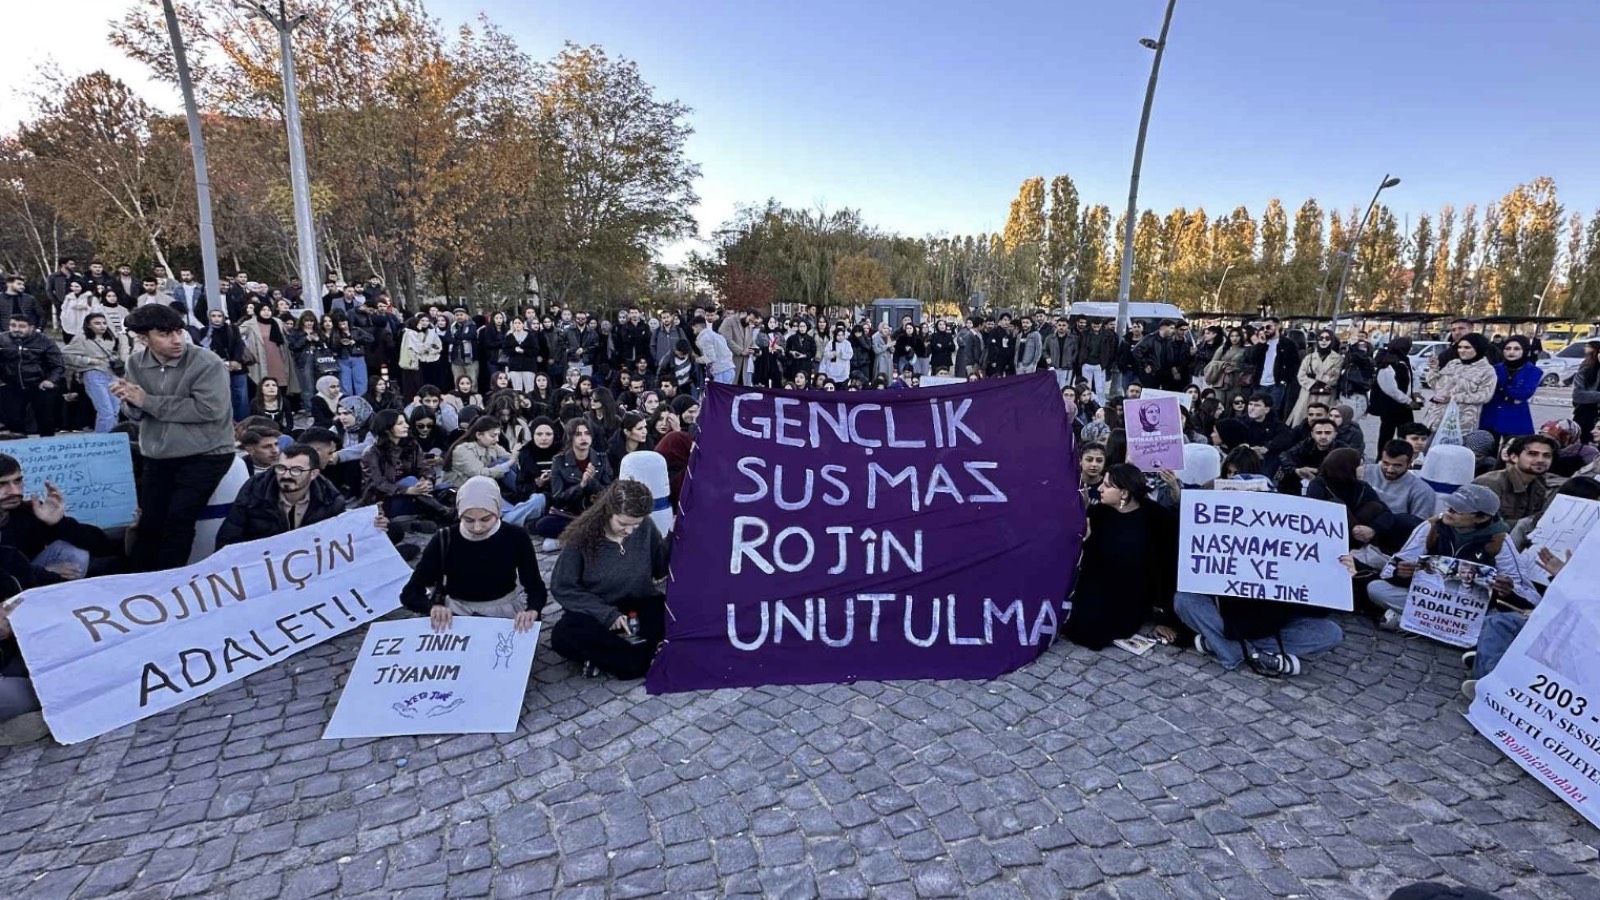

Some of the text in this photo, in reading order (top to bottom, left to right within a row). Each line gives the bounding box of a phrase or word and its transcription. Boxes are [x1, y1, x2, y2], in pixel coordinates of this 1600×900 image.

[730, 393, 982, 455] GENÇLİK
[1194, 503, 1344, 540] BERXWEDAN
[730, 516, 923, 575] ROJÎN
[1191, 533, 1320, 563] NASNAMEYA
[72, 533, 356, 643] ROJİN İÇİN
[1224, 580, 1266, 599] XETA
[371, 634, 471, 657] EZ JINIM
[1420, 620, 1431, 628] NE
[1434, 624, 1466, 637] OLDU?
[139, 588, 374, 708] ADALET!!
[373, 663, 461, 685] JÎYANIM
[1505, 687, 1558, 722] SUYUN
[1529, 674, 1588, 717] 2003
[1542, 741, 1600, 788] GİZLEYE
